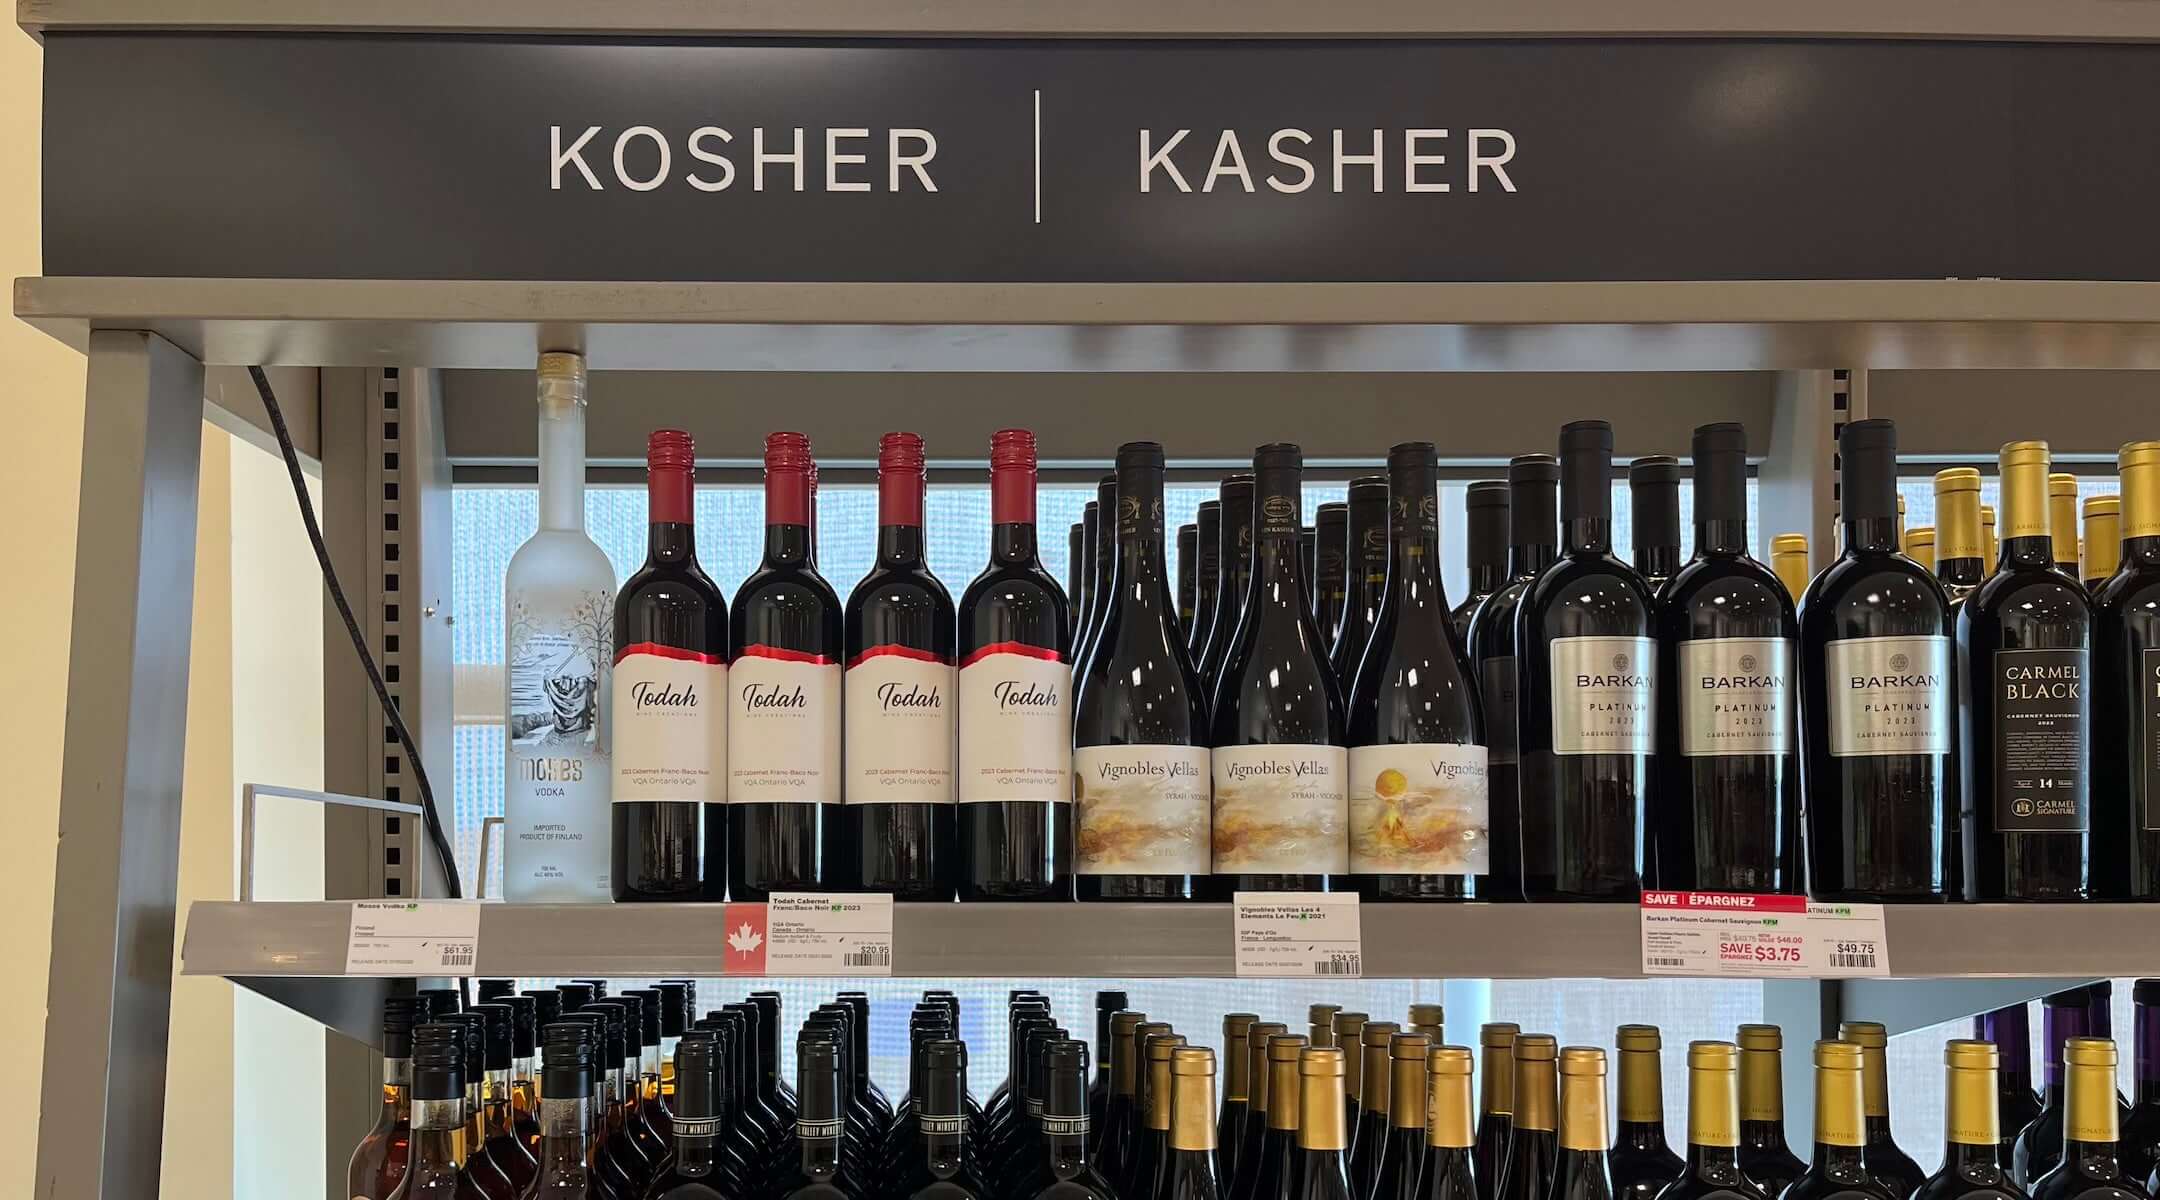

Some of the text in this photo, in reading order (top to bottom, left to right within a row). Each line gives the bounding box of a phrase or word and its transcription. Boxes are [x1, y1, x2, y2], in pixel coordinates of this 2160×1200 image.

[549, 126, 939, 193] KOSHER
[1139, 128, 1519, 194] KASHER
[2005, 666, 2080, 680] CARMEL
[1576, 674, 1653, 688] BARKAN
[1701, 676, 1785, 689] BARKAN
[1850, 675, 1941, 689] BARKAN
[631, 681, 698, 710] Todah
[877, 682, 942, 711] Todah
[994, 681, 1058, 710] Todah
[2006, 683, 2080, 700] BLACK
[742, 683, 806, 712] Todah
[1589, 703, 1647, 712] PLATINUM
[1714, 703, 1777, 713] PLATINUM
[1864, 703, 1931, 712] PLATINUM
[632, 768, 659, 776] Cabernet
[743, 769, 769, 777] Cabernet
[879, 768, 908, 776] Cabernet
[996, 768, 1025, 776] Cabernet
[1097, 759, 1200, 781] Vignobles Vellas
[1225, 759, 1329, 781] Vignobles Vellas
[632, 777, 697, 786] VQA Ontario VQA
[743, 778, 806, 787] VQA Ontario VQA
[880, 777, 942, 787] VQA Ontario VQA
[996, 777, 1058, 786] VQA Ontario VQA
[2039, 778, 2053, 789] 14
[535, 787, 565, 797] VODKA
[1165, 792, 1186, 800] SYRAH
[1290, 792, 1315, 800] SYRAH
[2036, 800, 2075, 808] CARMEL
[533, 824, 566, 832] IMPORTED
[519, 833, 582, 841] PRODUCT OF FINLAND
[1645, 892, 1756, 907] SAVE ÉPARGNEZ
[1240, 906, 1275, 914] Vignobles
[444, 946, 473, 954] $61.95
[860, 946, 889, 955] $20.95
[1720, 943, 1801, 961] SAVE $3.75
[1837, 943, 1875, 953] $49.75
[1331, 954, 1360, 962] $34.95
